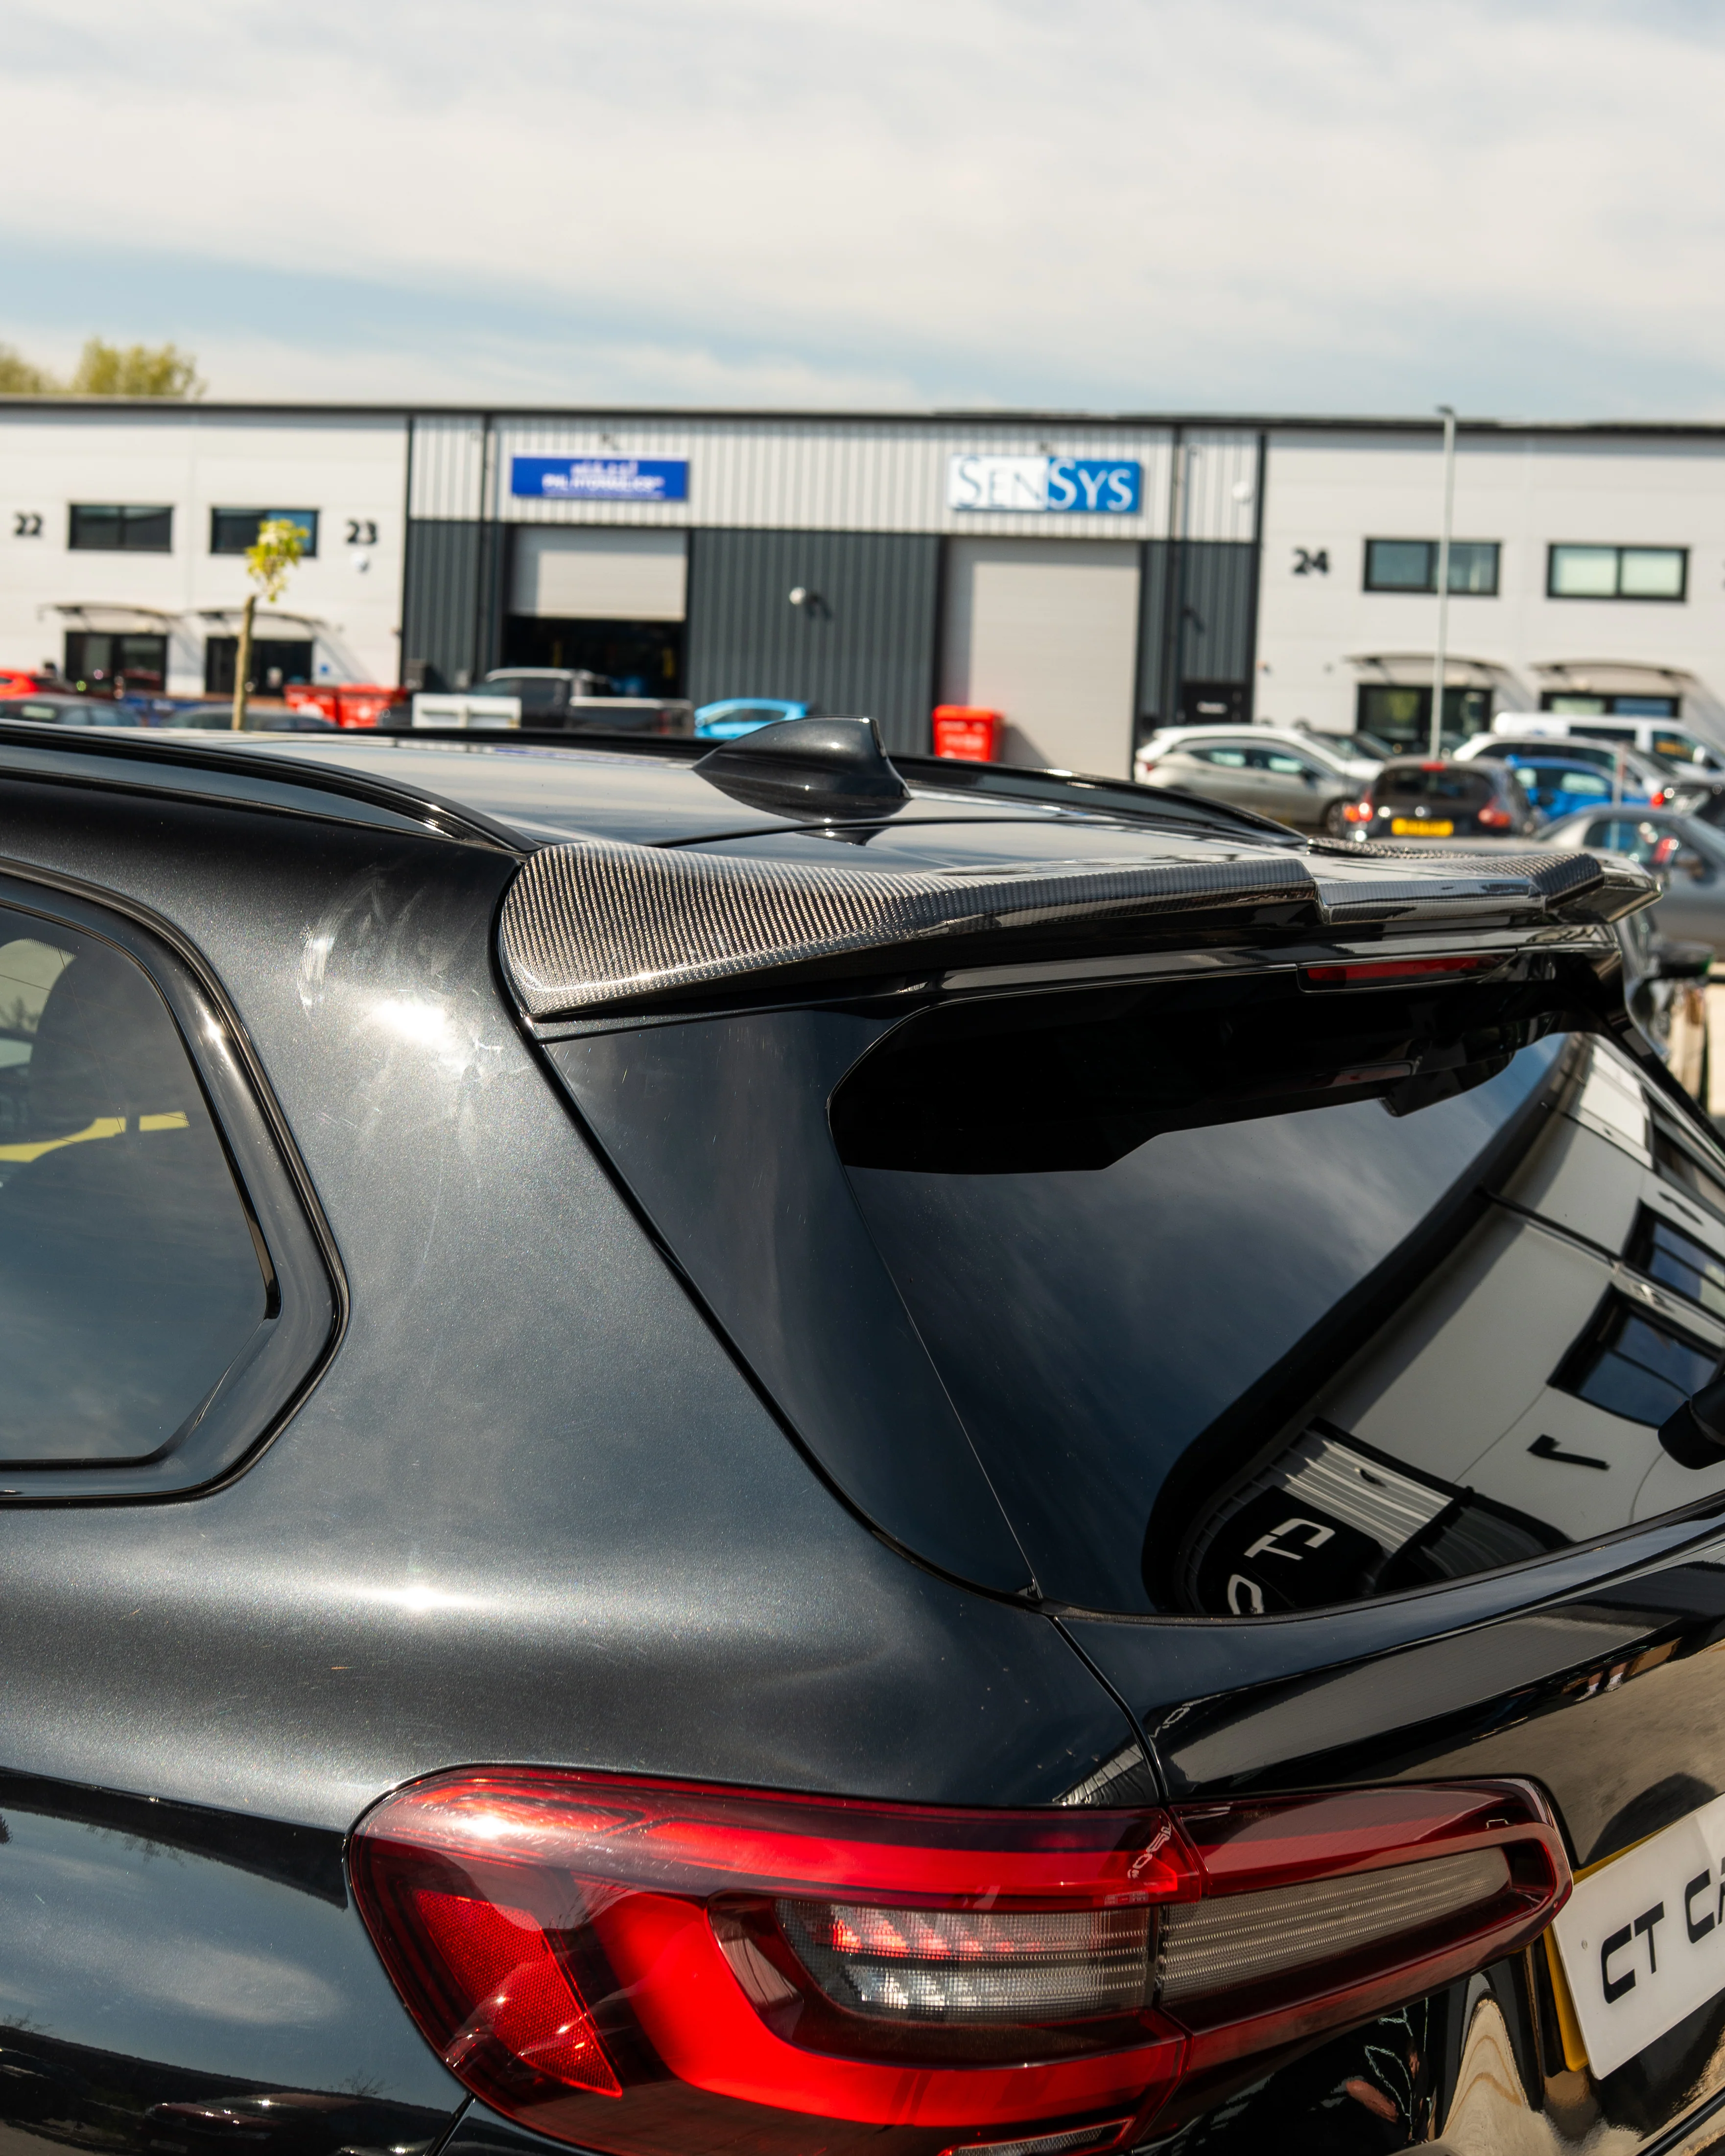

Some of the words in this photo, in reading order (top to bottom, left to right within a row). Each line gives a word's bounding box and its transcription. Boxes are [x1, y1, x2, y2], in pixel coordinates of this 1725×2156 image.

[14, 512, 43, 537] 22
[346, 518, 378, 545] 23
[1292, 547, 1329, 576] 24
[1601, 1901, 1665, 2004] CT
